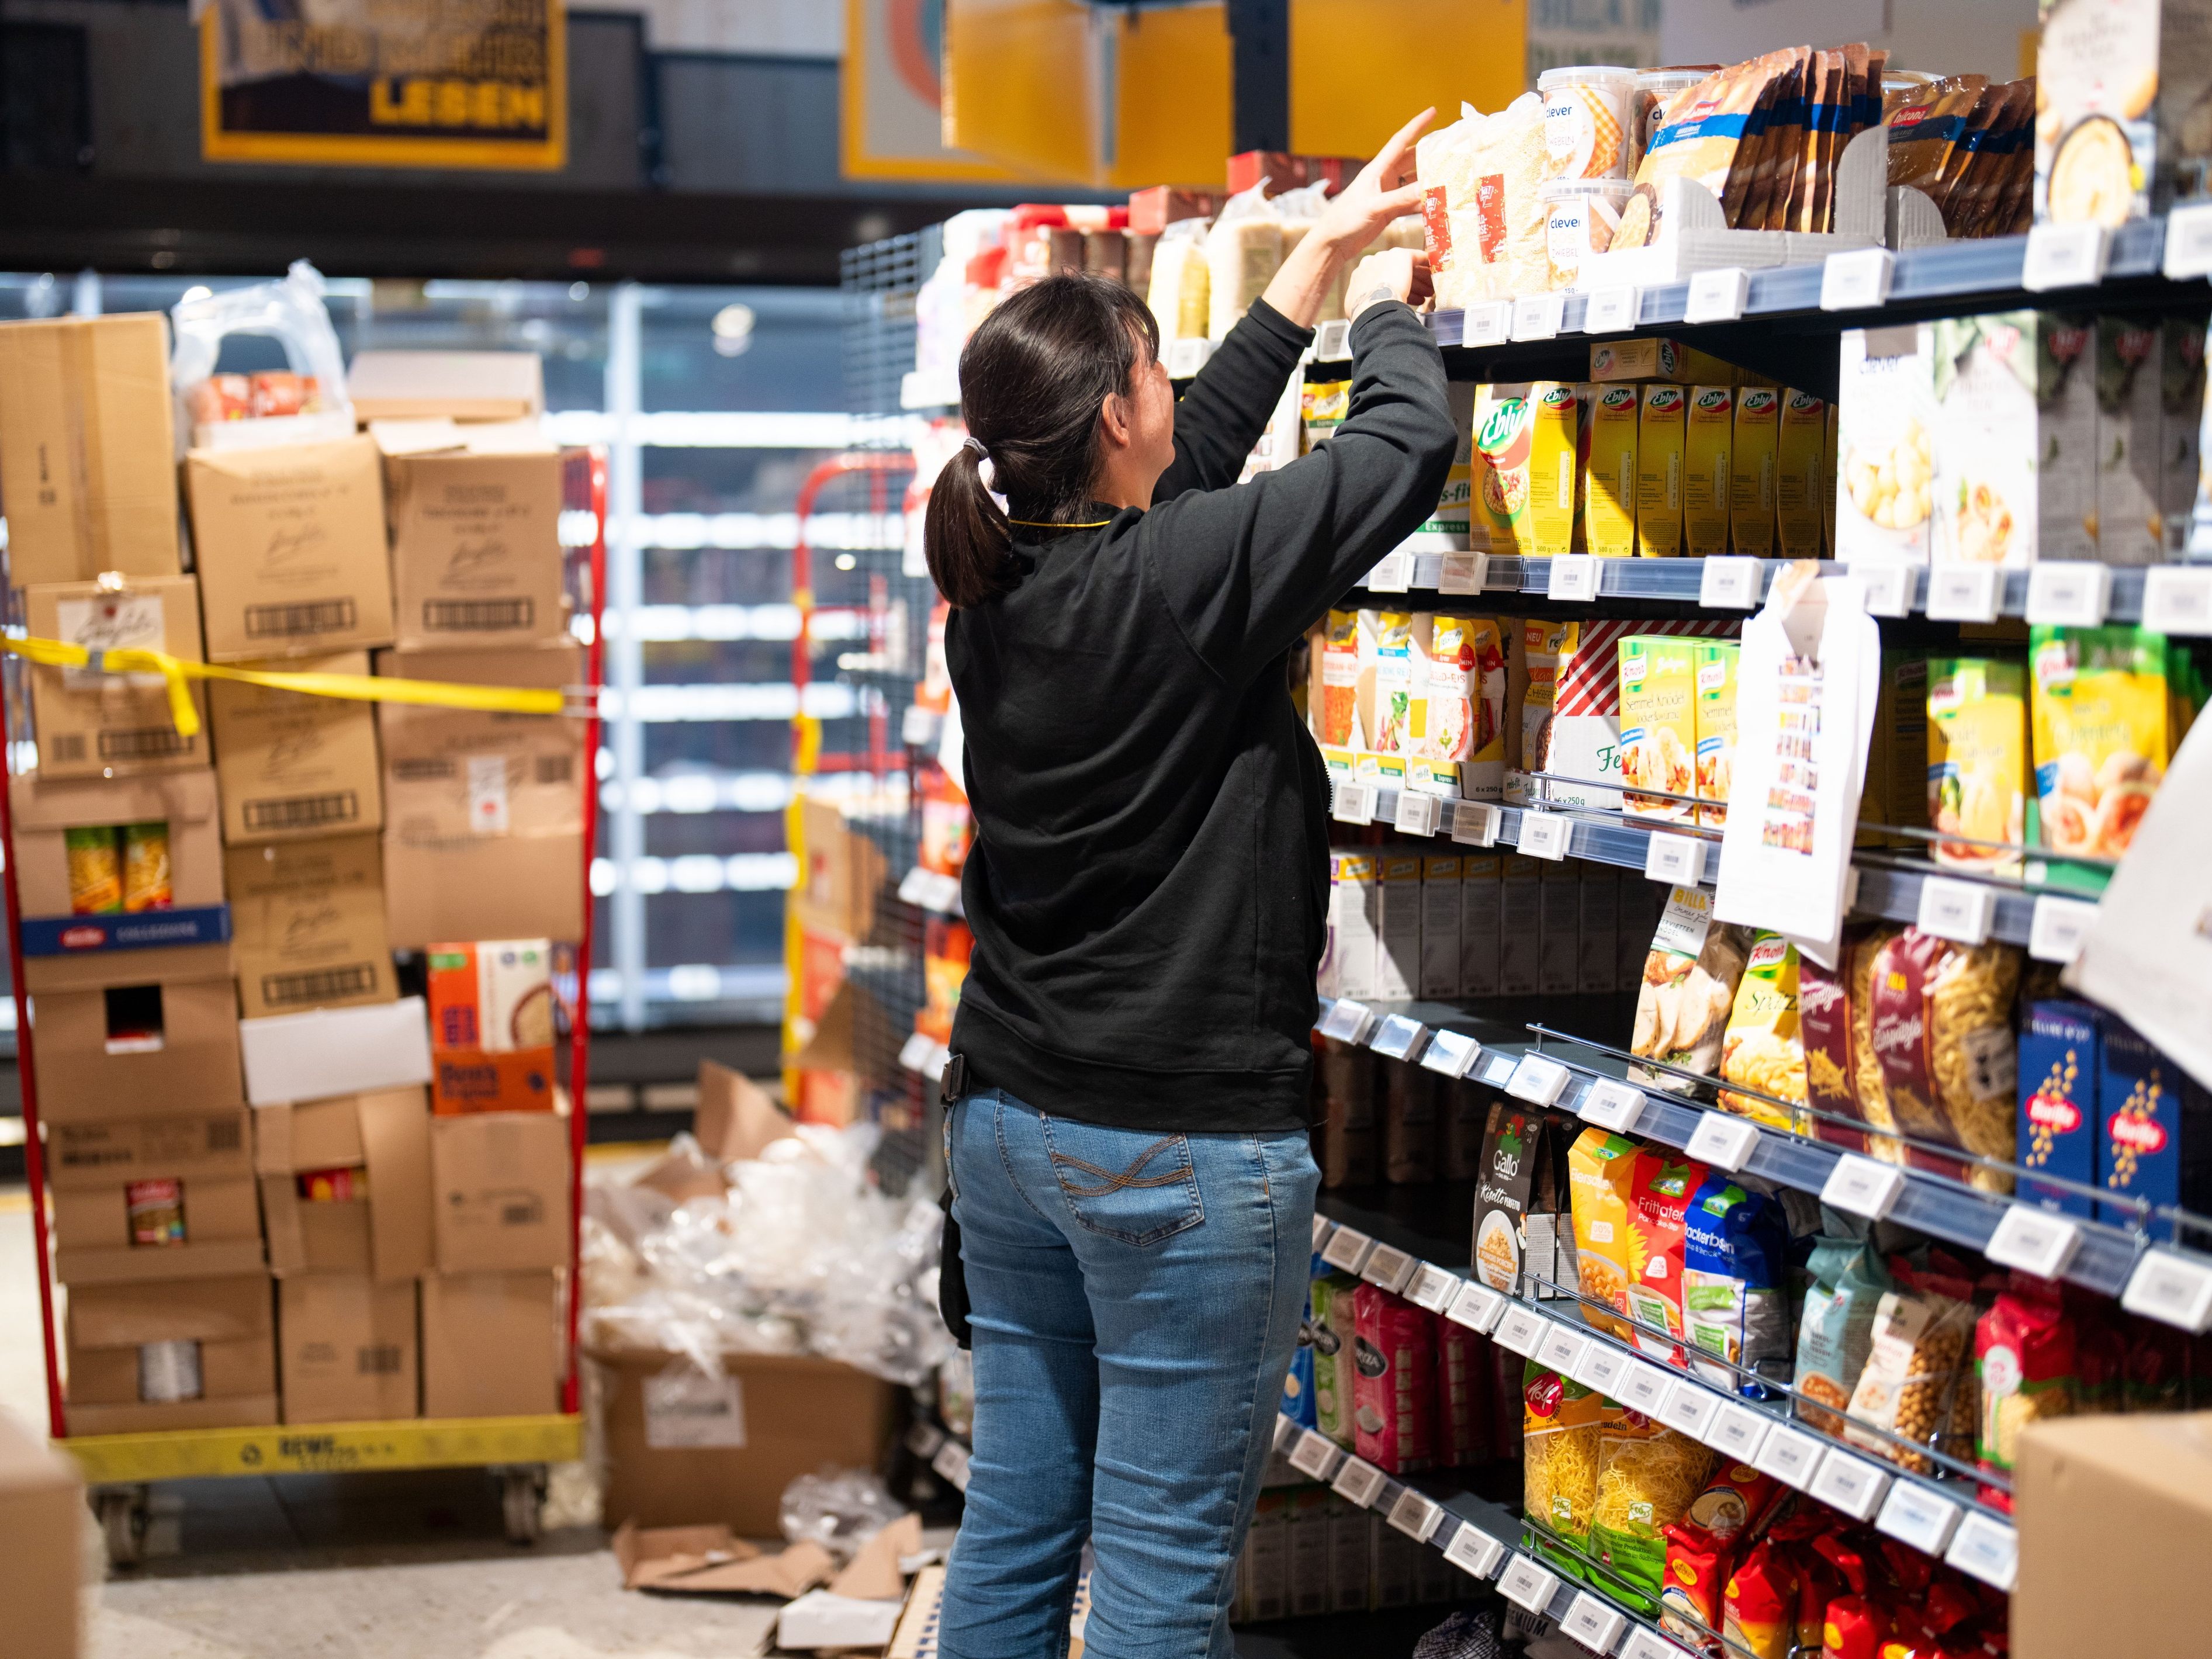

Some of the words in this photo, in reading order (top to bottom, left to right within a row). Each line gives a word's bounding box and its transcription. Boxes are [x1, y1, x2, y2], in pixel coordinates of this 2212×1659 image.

[1546, 106, 1572, 118] clever
[1893, 110, 1926, 124] hilcona
[1663, 344, 1674, 373] Ebly
[1545, 390, 1569, 403] Ebly
[1605, 391, 1629, 404] Ebly
[1653, 392, 1677, 405] Ebly
[1699, 393, 1723, 406] Ebly
[1746, 394, 1770, 407] Ebly
[1793, 395, 1816, 407] Ebly
[1482, 404, 1526, 445] Ebly
[1425, 522, 1466, 532] Express
[1526, 632, 1541, 642] NEU
[1626, 697, 1653, 711] Semmel
[1657, 691, 1684, 707] Knödel
[1702, 706, 1732, 719] Semmel
[1416, 767, 1429, 778] reis-fit
[1438, 775, 1452, 784] Express
[1507, 777, 1520, 789] reis-fit
[1524, 781, 1540, 799] Feelgoo
[1568, 796, 1580, 805] 250
[1580, 798, 1585, 806] g
[1673, 888, 1706, 911] BILLA
[1749, 943, 1785, 964] Knorr
[1745, 990, 1797, 1017] Spätz
[1493, 1149, 1518, 1176] Gallo
[1480, 1182, 1507, 1205] Risotto
[1504, 1196, 1521, 1212] PERFETTO
[1497, 1257, 1514, 1270] PORCINI
[1528, 1379, 1560, 1410] Wolf
[1618, 1535, 1636, 1543] Familie
[1624, 1543, 1652, 1554] Produktion
